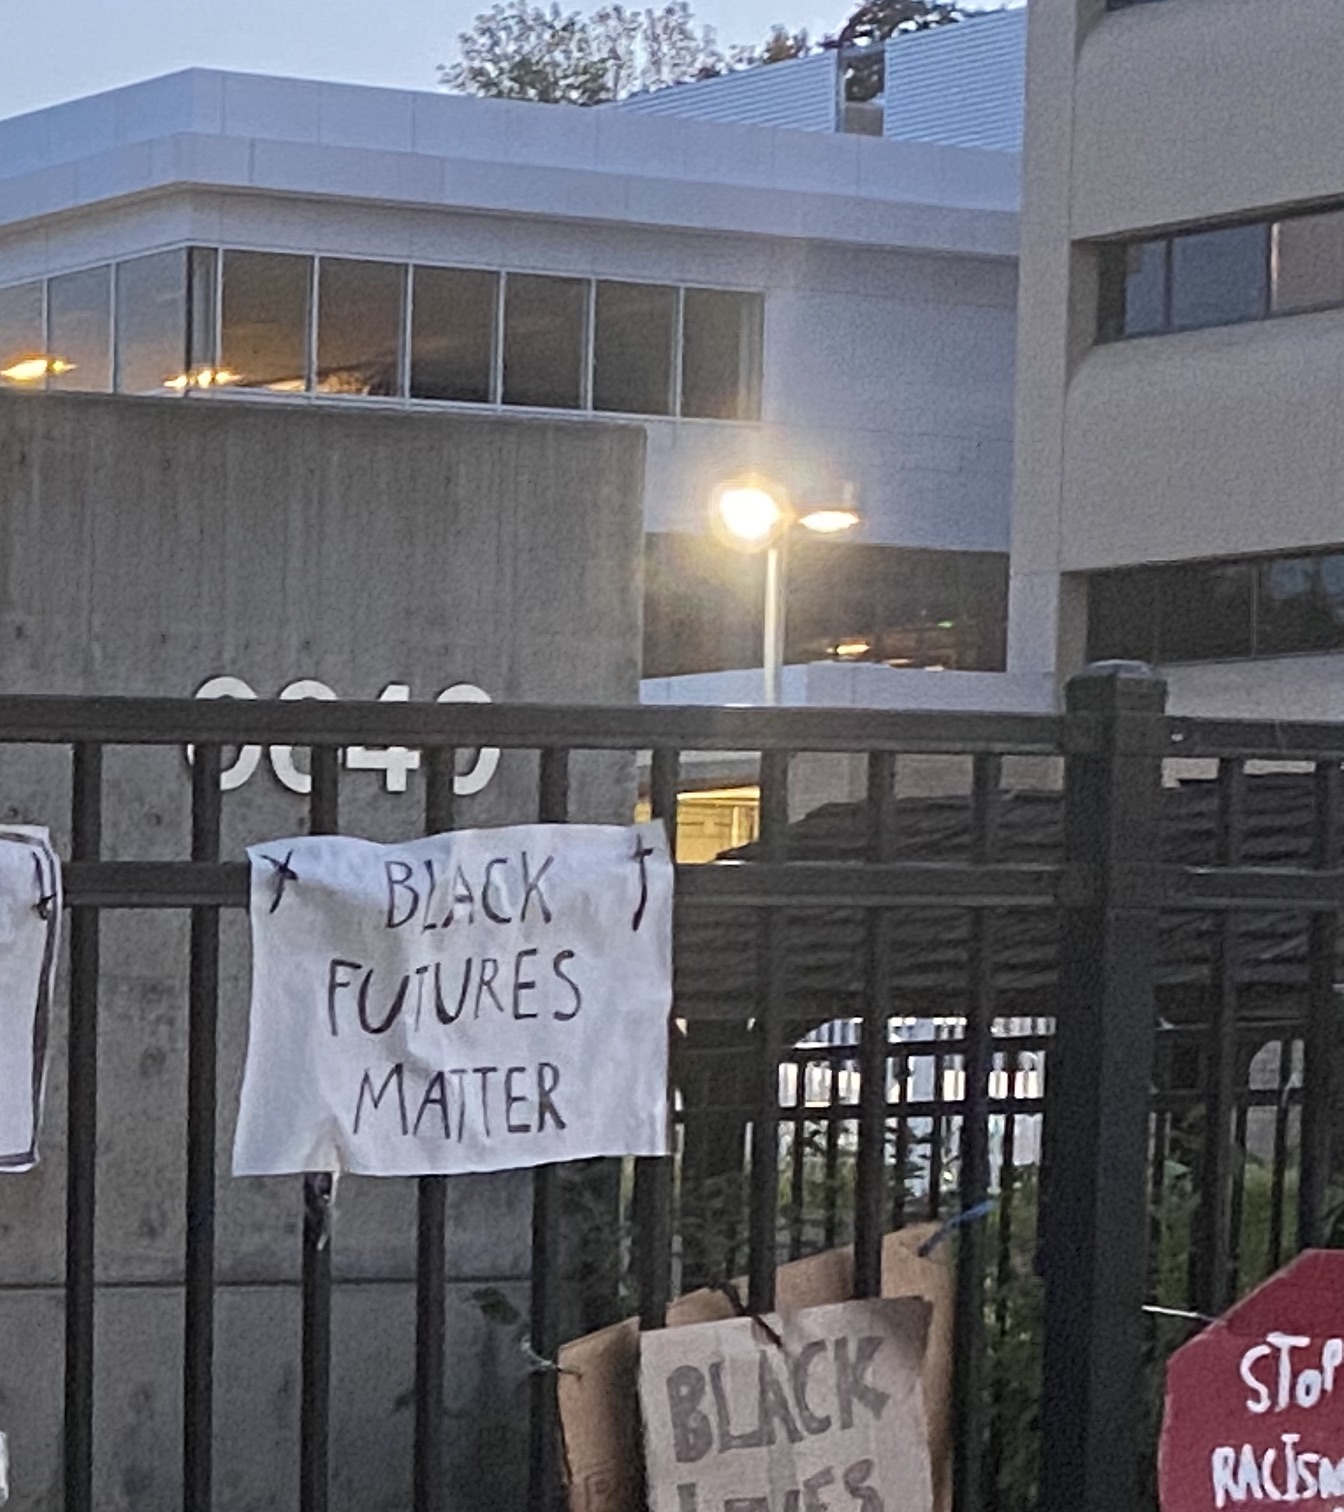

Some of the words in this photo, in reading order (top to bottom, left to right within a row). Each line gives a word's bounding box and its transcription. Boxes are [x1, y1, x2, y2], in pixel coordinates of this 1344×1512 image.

[384, 850, 555, 934] BLACK
[327, 948, 582, 1037] FUTURES
[352, 1062, 567, 1143] MATTER
[666, 1334, 892, 1464] BLACK
